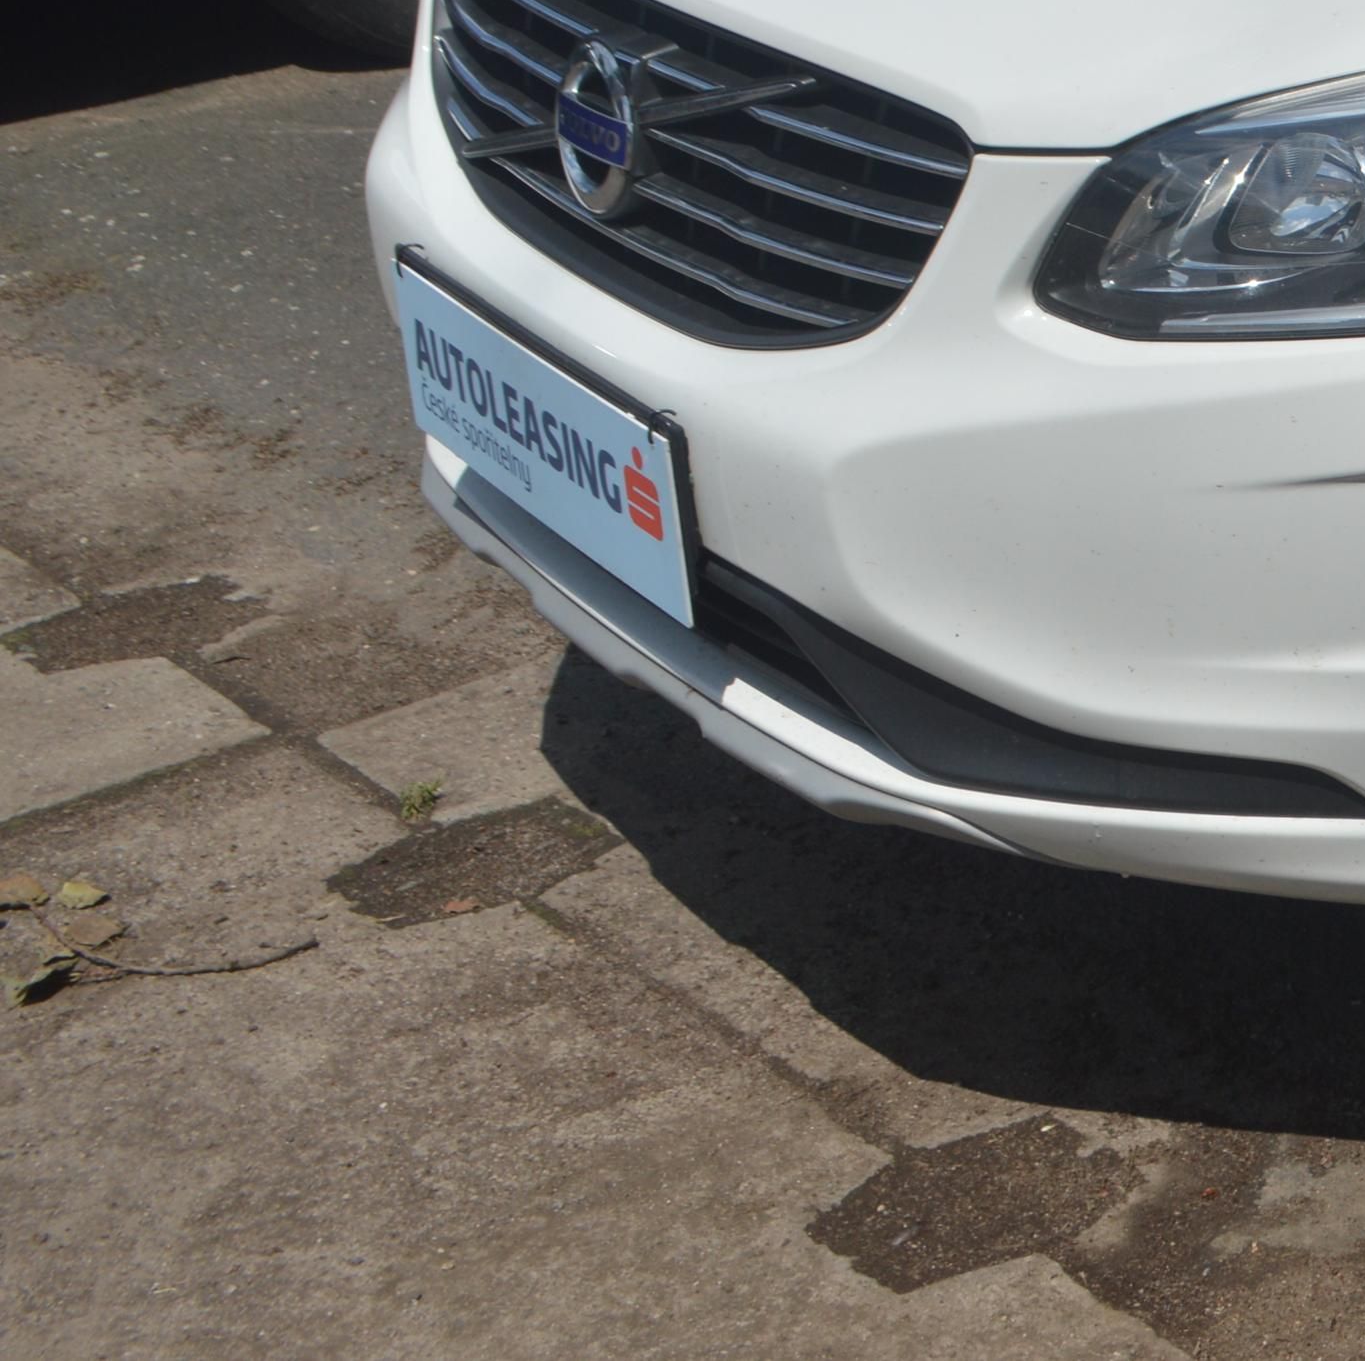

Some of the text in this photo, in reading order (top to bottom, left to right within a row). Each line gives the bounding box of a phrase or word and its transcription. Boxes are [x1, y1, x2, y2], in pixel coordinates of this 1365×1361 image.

[414, 318, 622, 514] AUTOLEASING
[421, 375, 533, 493] České spořitelny
